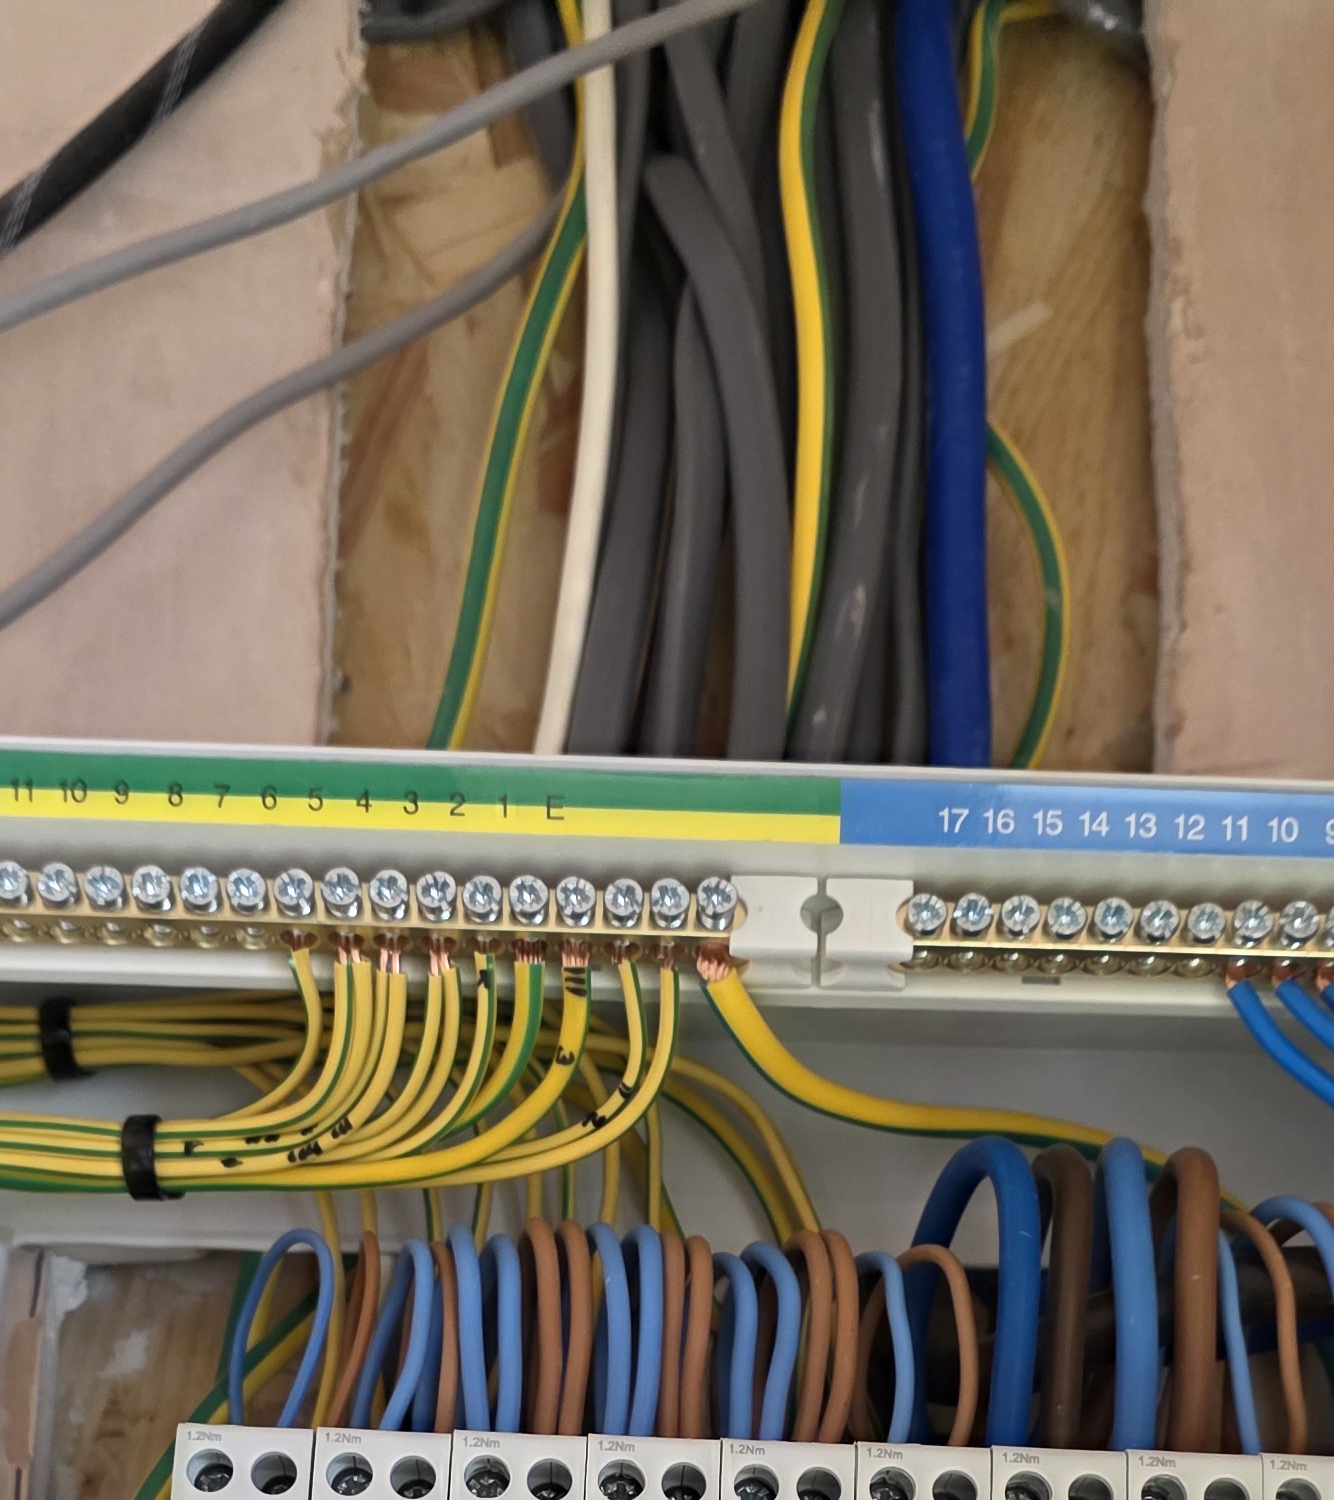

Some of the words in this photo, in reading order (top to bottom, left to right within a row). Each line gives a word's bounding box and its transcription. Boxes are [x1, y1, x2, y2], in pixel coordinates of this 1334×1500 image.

[11, 777, 35, 802] 11
[58, 778, 88, 804] 10
[114, 780, 131, 806] 9
[168, 782, 184, 807] 8
[214, 784, 231, 808] 7
[261, 785, 278, 810] 6
[308, 787, 324, 811] 5
[356, 788, 373, 813] 4
[403, 790, 420, 815] 3
[449, 792, 467, 817] 2
[499, 795, 509, 819] 1
[546, 795, 565, 821] E
[939, 808, 969, 833] 17
[983, 809, 1015, 835] 16
[1033, 810, 1063, 836] 15
[1079, 812, 1109, 837] 14
[1125, 813, 1157, 839] 13
[1174, 815, 1205, 841] 12
[1222, 816, 1248, 842] 11
[1268, 817, 1299, 843] 10
[325, 1432, 362, 1444] 1.2Nm
[730, 1444, 765, 1455] 1.2Nm
[1002, 1453, 1040, 1464] 1.2Nm
